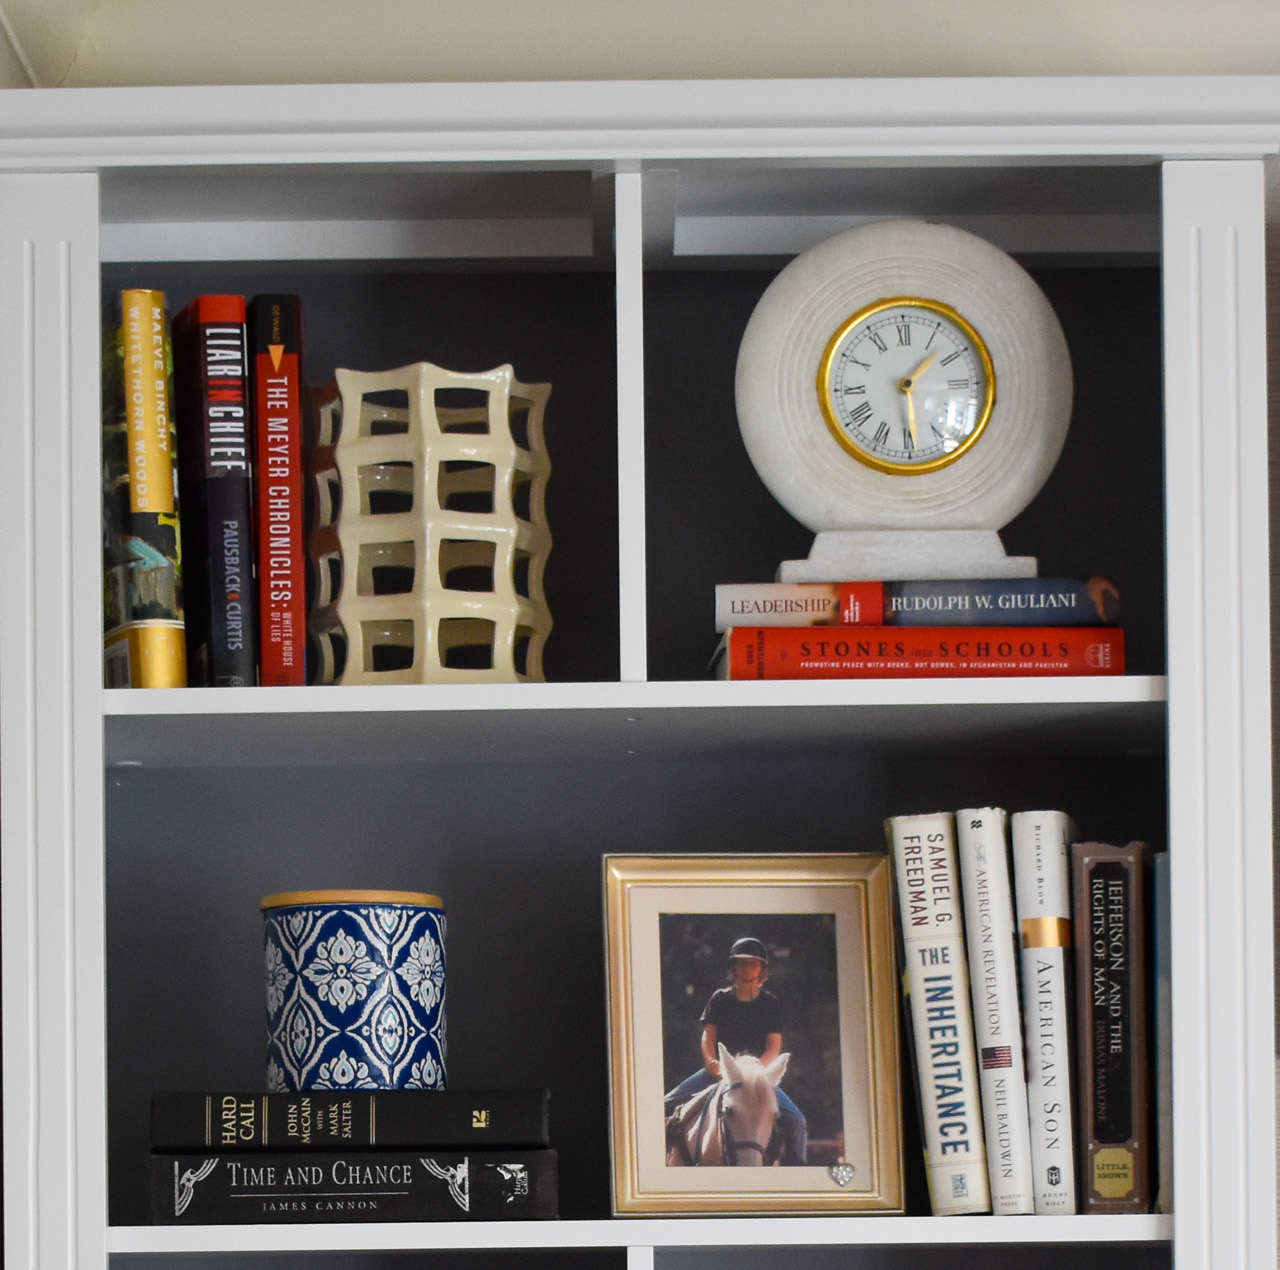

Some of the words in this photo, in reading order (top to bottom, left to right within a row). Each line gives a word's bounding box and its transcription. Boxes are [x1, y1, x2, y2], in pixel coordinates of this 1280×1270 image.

[152, 308, 163, 371] MAEVE
[205, 328, 242, 377] LIAR
[129, 306, 144, 431] WHITETHORN
[207, 380, 243, 402] IN
[267, 376, 287, 409] THE
[155, 380, 168, 452] BINCHY
[209, 406, 246, 471] CHIEF
[267, 417, 289, 477] MEYER
[135, 441, 149, 508] WOODS
[223, 520, 240, 593] PAUSBACK
[271, 612, 279, 625] OF
[731, 598, 831, 614] LEADERSHIP
[892, 595, 970, 612] RUDOLPH
[972, 595, 993, 610] W.
[998, 593, 1076, 610] GIULIANI
[226, 601, 243, 650] CURTIS
[271, 625, 281, 643] LIES
[283, 612, 292, 638] WHITE
[283, 640, 294, 667] HOUSE
[800, 641, 906, 658] STONES
[939, 640, 1071, 658] SCHOOLS
[902, 835, 929, 927] FREEDMAN
[927, 834, 950, 906] SAMUEL
[937, 913, 953, 928] G.
[977, 869, 994, 945] AMERICAN
[1093, 878, 1106, 934] RIGHTS
[1108, 880, 1124, 971] JEFFERSON
[919, 946, 950, 967] THE
[1093, 940, 1105, 960] OF
[983, 950, 1001, 1036] REVELATION
[1094, 967, 1106, 1006] MAN
[1110, 981, 1123, 1017] AND
[1036, 959, 1057, 1089] AMERICAN
[1096, 1020, 1106, 1064] DUMAS
[1110, 1022, 1123, 1054] THE
[922, 974, 970, 1156] INHERITANCE
[994, 1078, 1006, 1110] NEIL
[1097, 1068, 1107, 1124] MALONE
[222, 1096, 237, 1144] HARD
[240, 1099, 254, 1141] CALL
[288, 1104, 299, 1137] JOHN
[330, 1104, 338, 1136] MARK
[342, 1101, 351, 1138] SALTER
[1043, 1102, 1061, 1150] SON
[997, 1112, 1013, 1178] BALDWIN
[227, 1163, 276, 1186] TIME
[284, 1164, 323, 1186] AND
[332, 1160, 413, 1185] CHANCE
[263, 1202, 307, 1212] JAMES
[315, 1200, 378, 1211] CANNON
